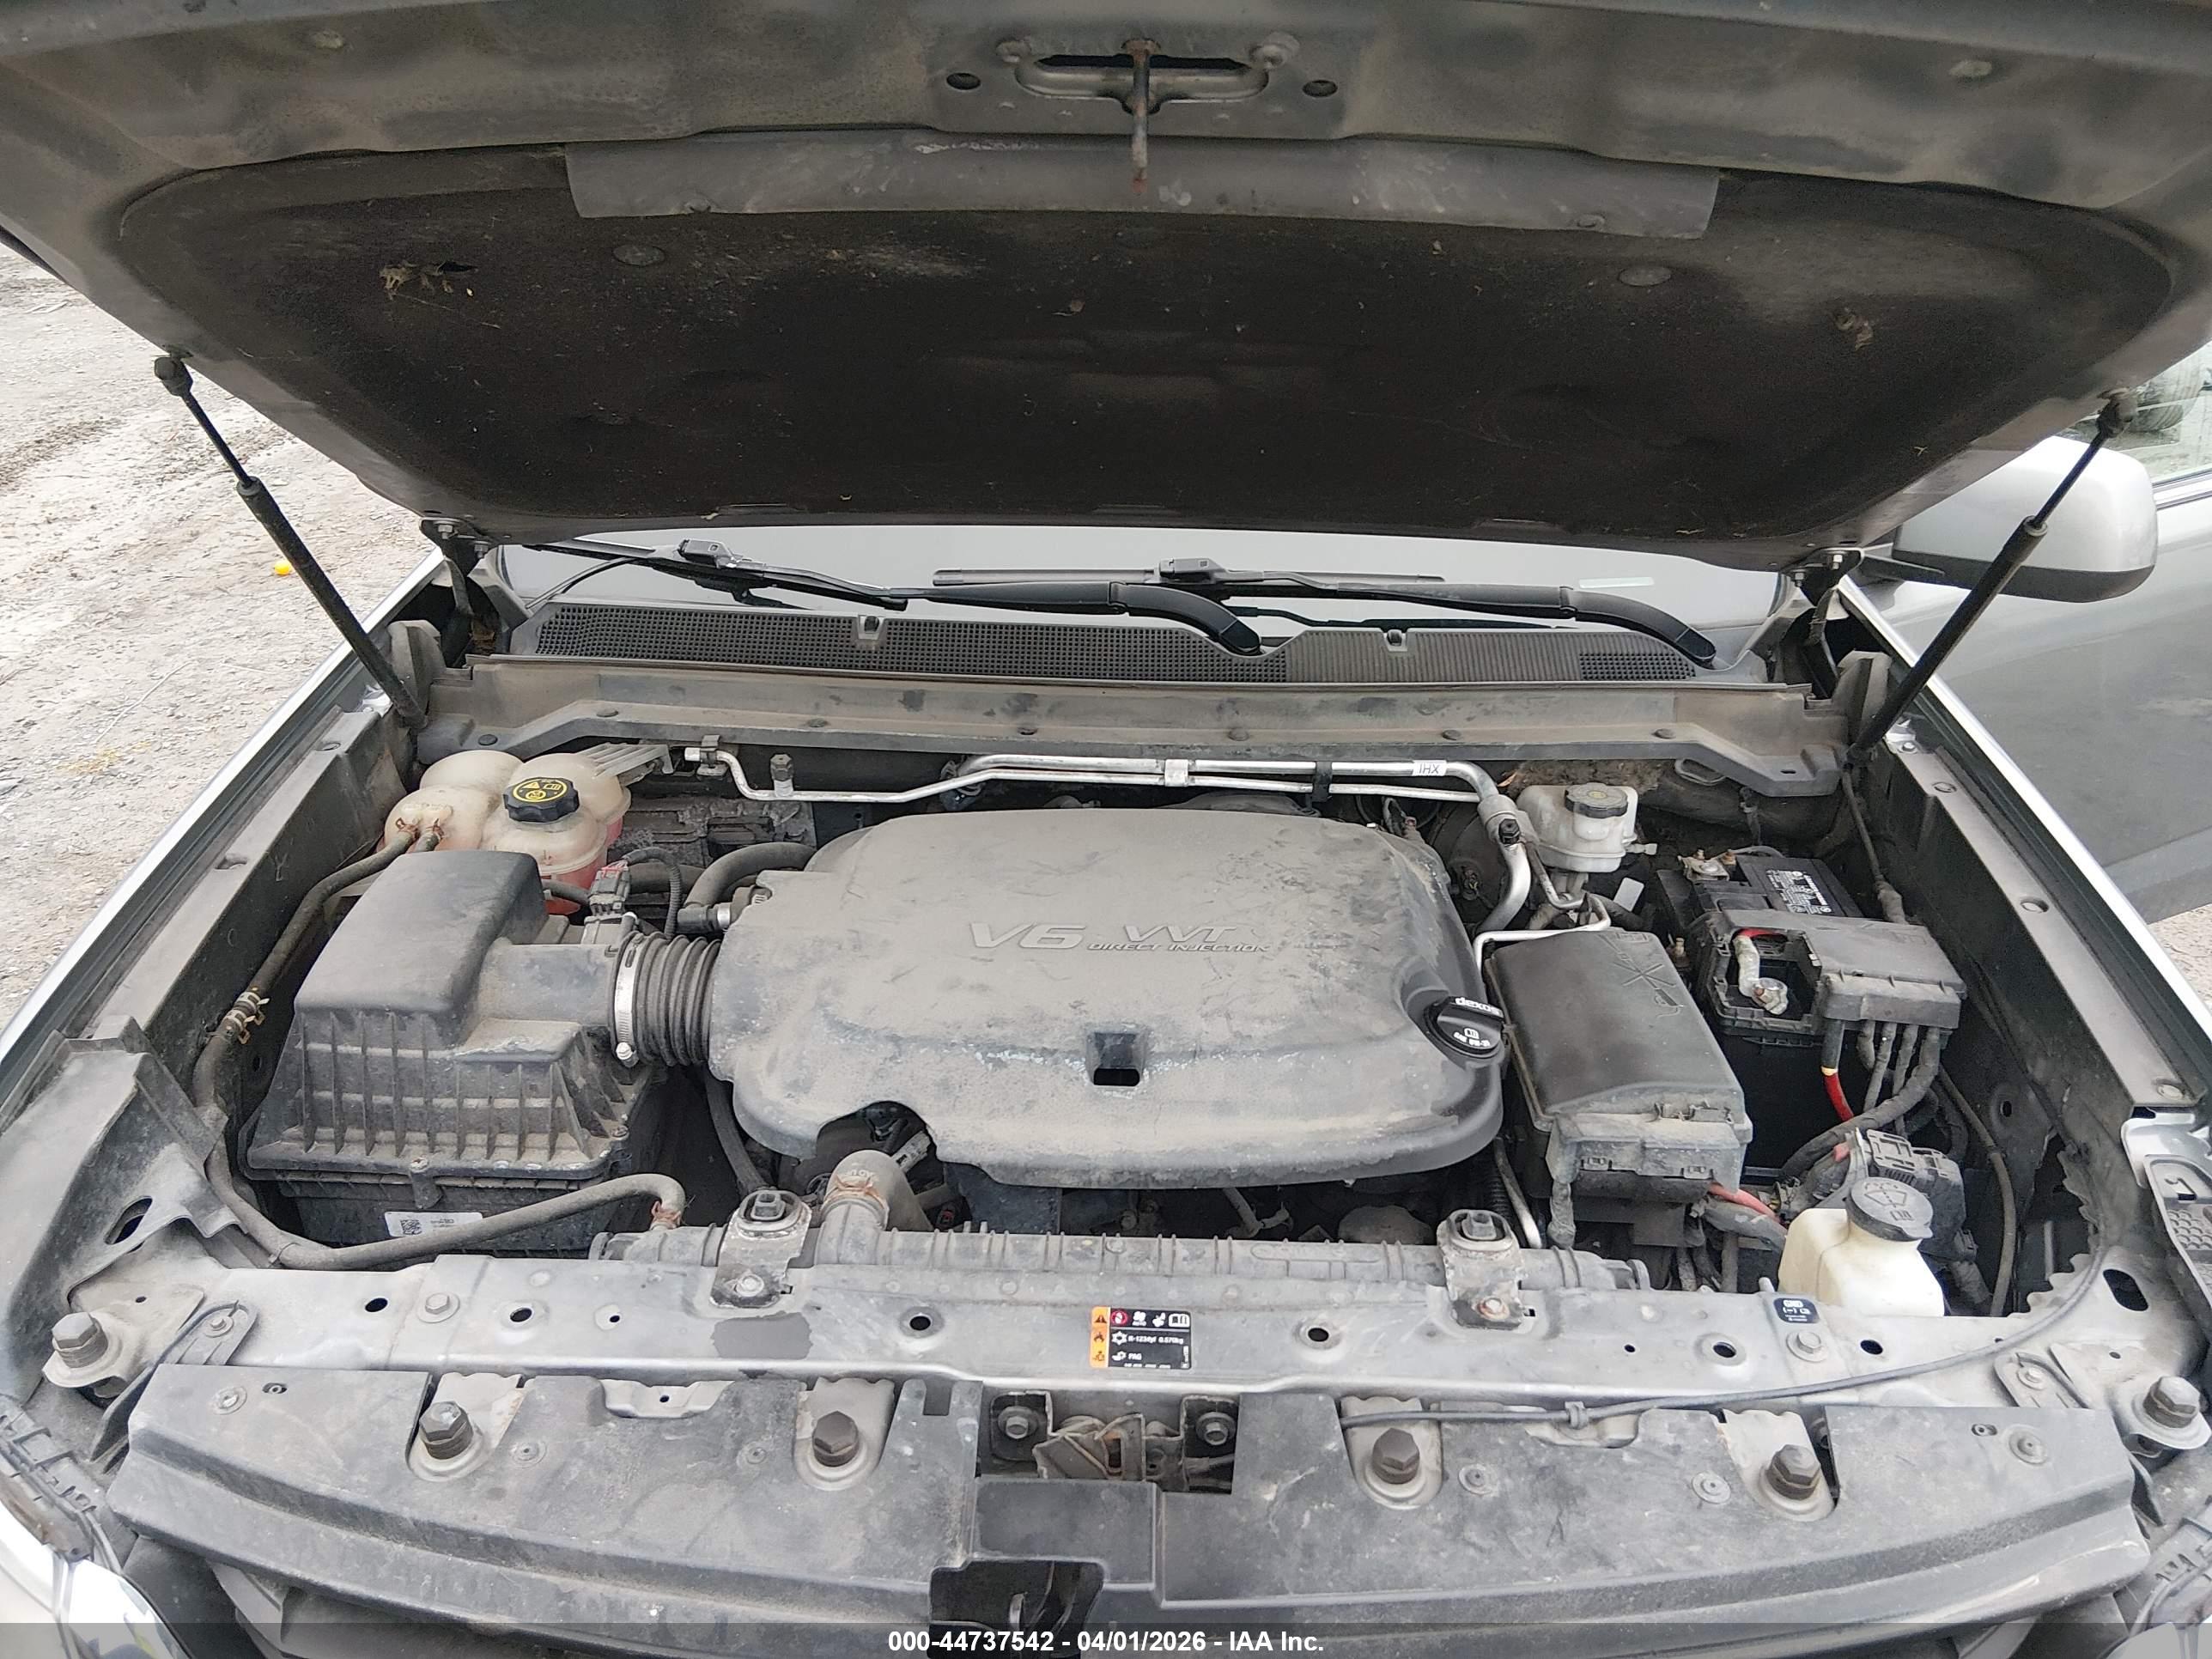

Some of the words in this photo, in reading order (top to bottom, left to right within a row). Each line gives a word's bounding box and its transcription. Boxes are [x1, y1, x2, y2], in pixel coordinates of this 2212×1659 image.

[969, 922, 1085, 950] V6
[1124, 924, 1237, 943] VVT
[1087, 943, 1161, 951] DIRECT
[1168, 943, 1269, 952] INJECTION
